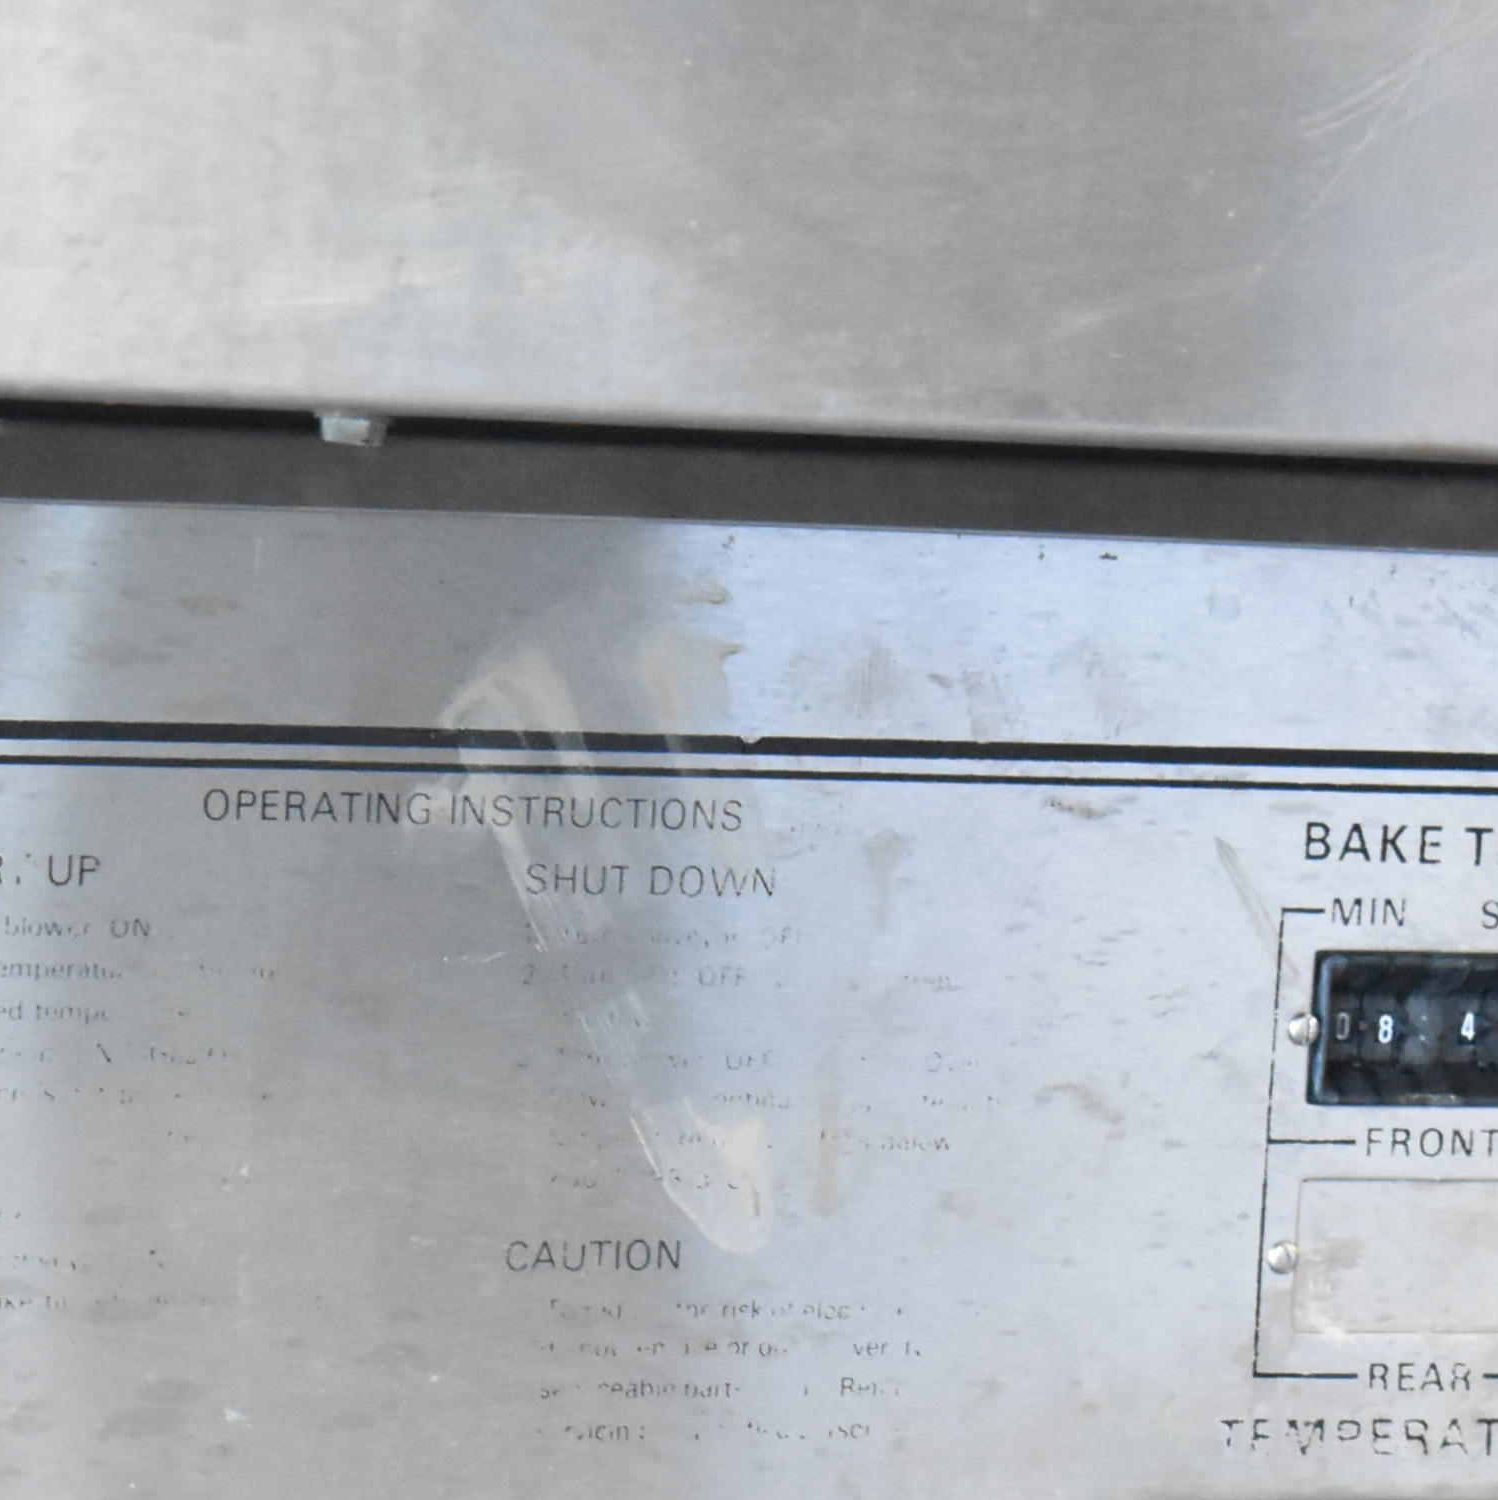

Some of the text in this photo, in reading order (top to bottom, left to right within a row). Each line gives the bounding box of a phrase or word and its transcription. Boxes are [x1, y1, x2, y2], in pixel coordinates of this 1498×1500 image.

[203, 787, 744, 833] OPERATING INSTRUCTIONS
[1304, 821, 1443, 865] BAKE
[48, 854, 100, 887] UP
[526, 862, 776, 898] SHUT DOWN
[1330, 897, 1407, 927] MIN
[505, 1239, 681, 1272] CAUTION
[1367, 1362, 1472, 1392] REAR
